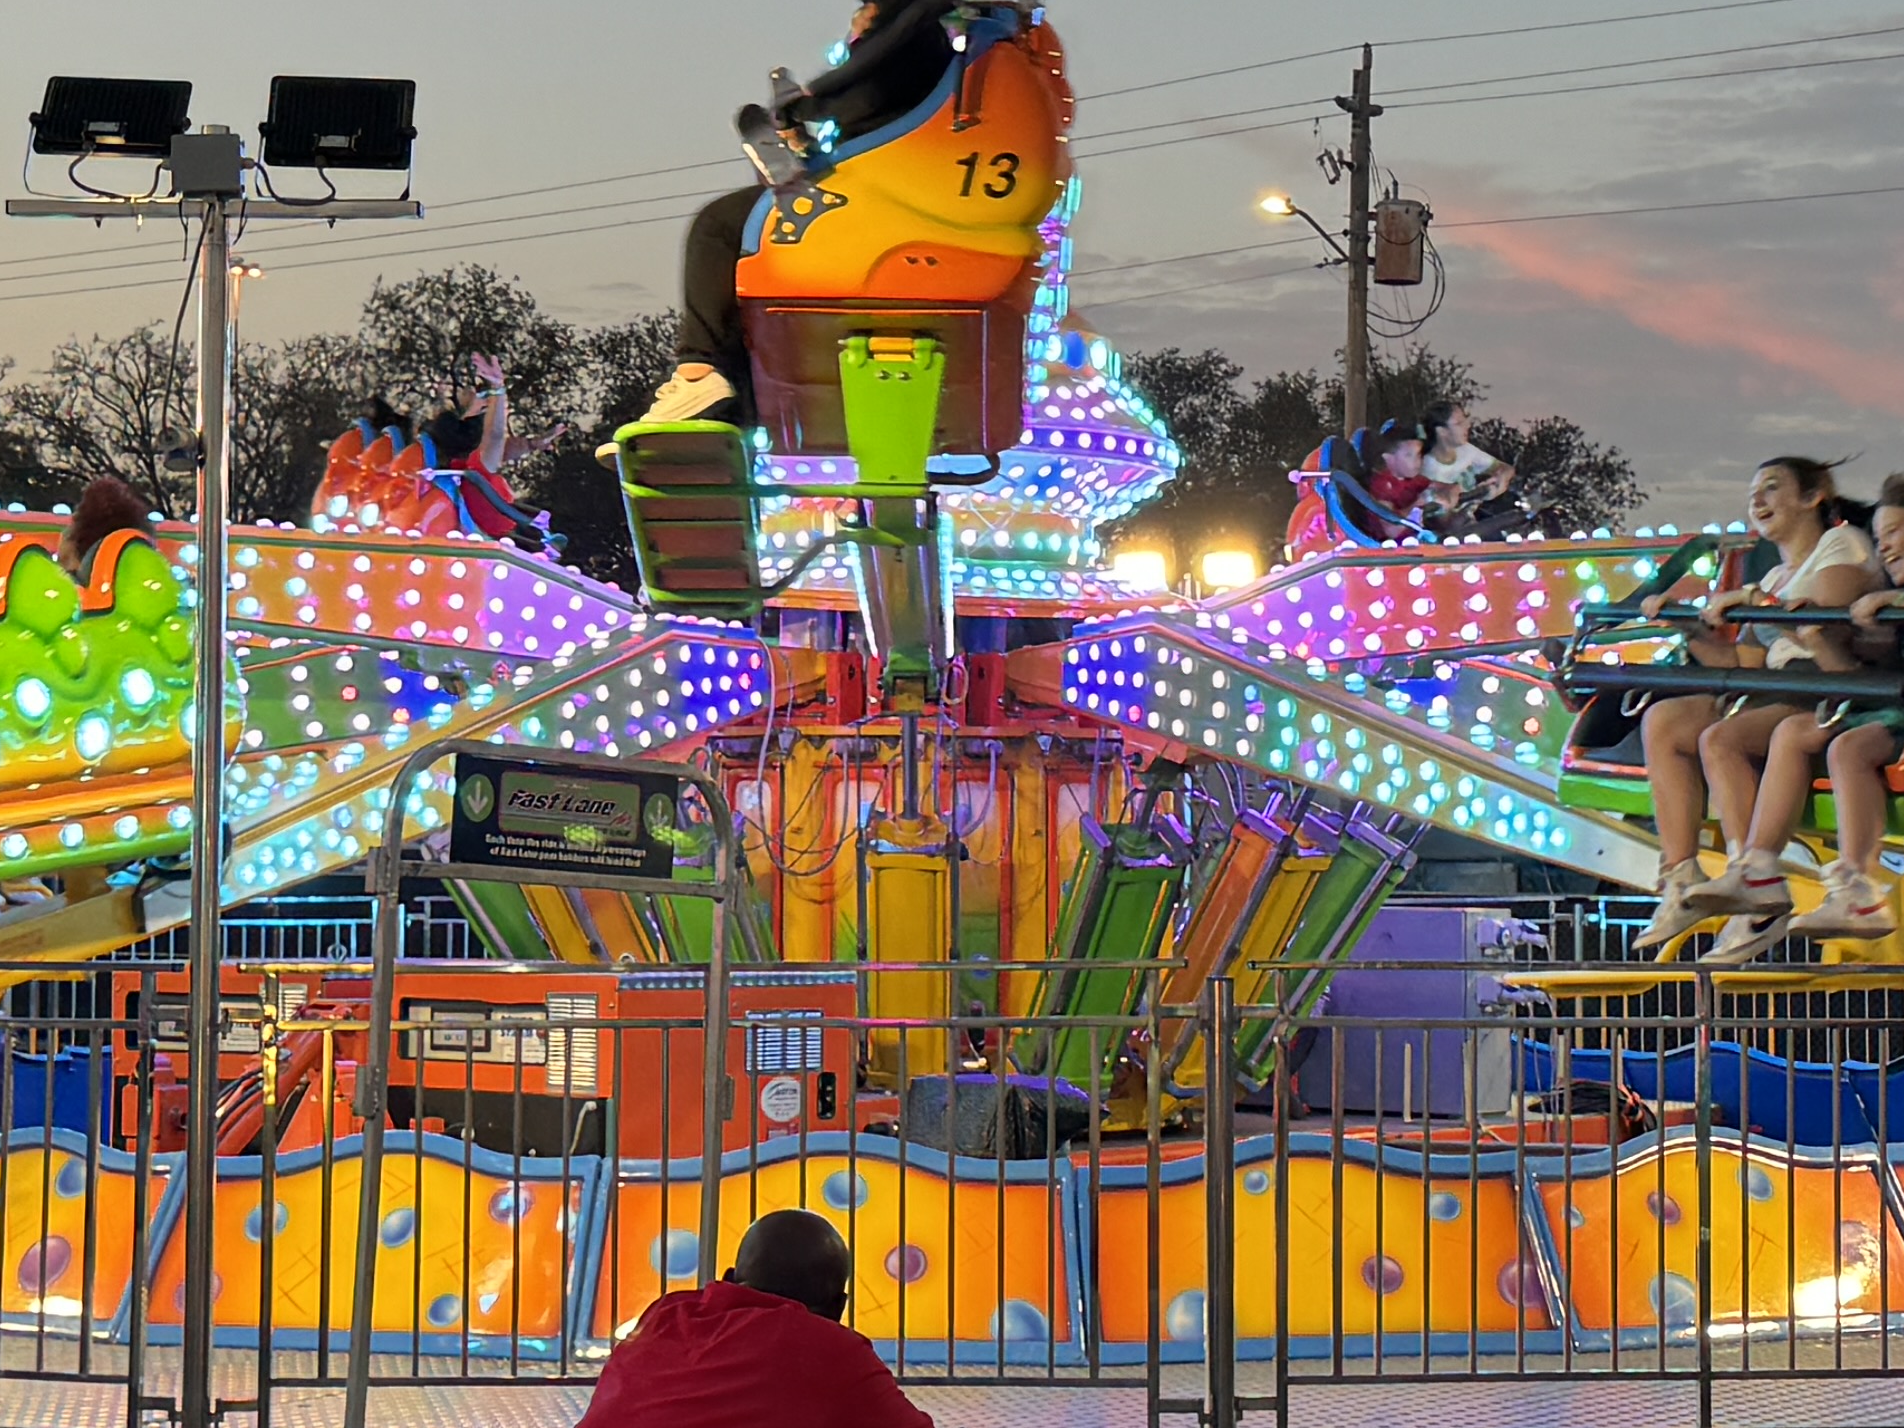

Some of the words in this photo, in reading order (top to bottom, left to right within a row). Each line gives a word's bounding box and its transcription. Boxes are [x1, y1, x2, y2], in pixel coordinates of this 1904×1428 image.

[955, 151, 1020, 199] 13
[508, 789, 560, 810] Fast
[561, 795, 616, 816] Lane
